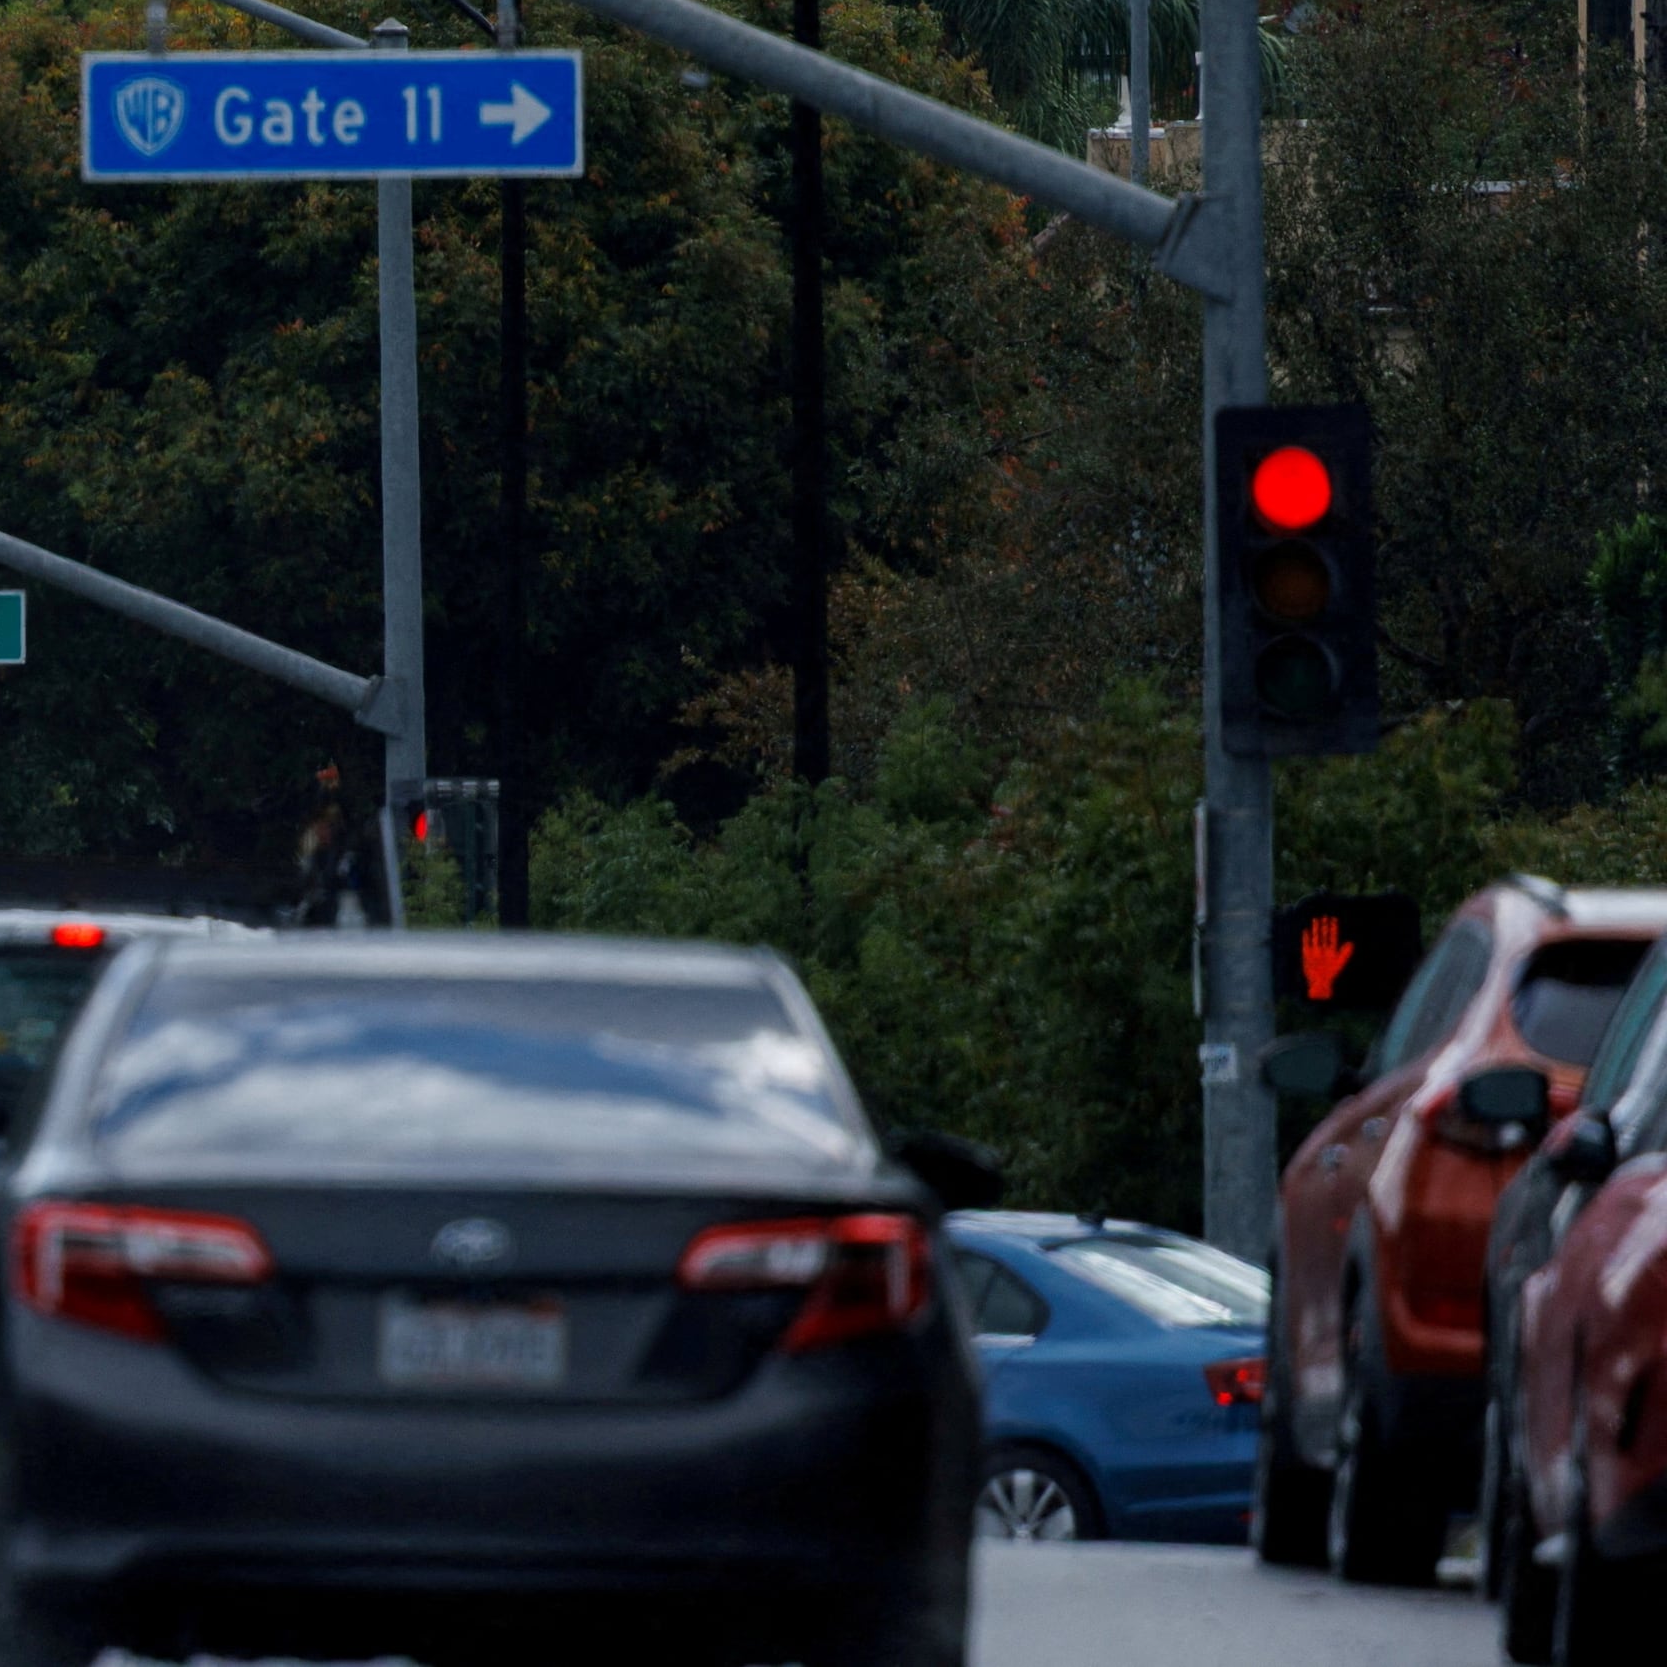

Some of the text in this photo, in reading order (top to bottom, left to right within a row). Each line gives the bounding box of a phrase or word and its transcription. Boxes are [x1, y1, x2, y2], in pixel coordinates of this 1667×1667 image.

[121, 84, 177, 145] WB
[214, 84, 441, 147] Gate 11
